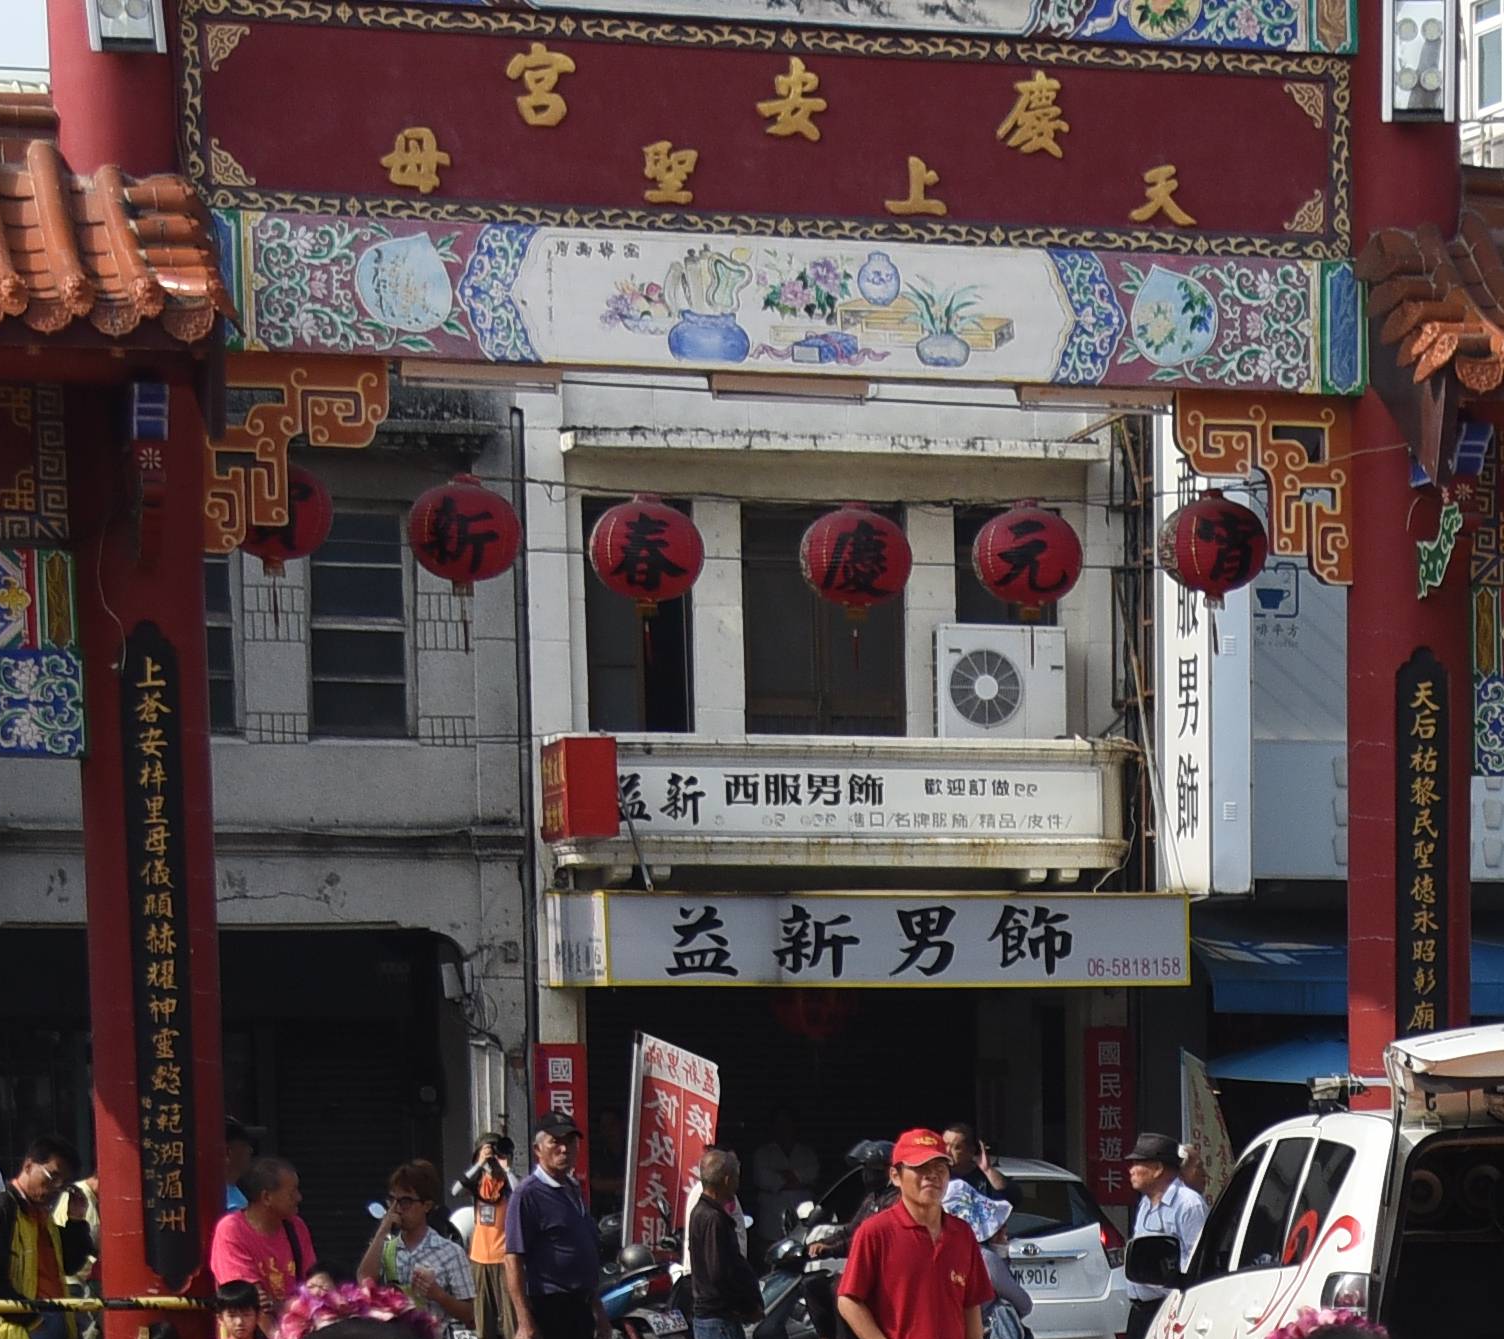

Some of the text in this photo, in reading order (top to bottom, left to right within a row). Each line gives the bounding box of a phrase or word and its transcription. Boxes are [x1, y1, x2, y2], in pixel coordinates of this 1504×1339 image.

[505, 42, 1070, 160] 慶安宮
[380, 127, 1198, 227] 天上聖母
[723, 773, 884, 807] 西服男飾
[924, 777, 1010, 797] 歡迎訂做
[665, 905, 1074, 979] 益新男飾
[1087, 957, 1183, 977] 06-5818158
[1097, 1040, 1124, 1194] 國民旅遊卡
